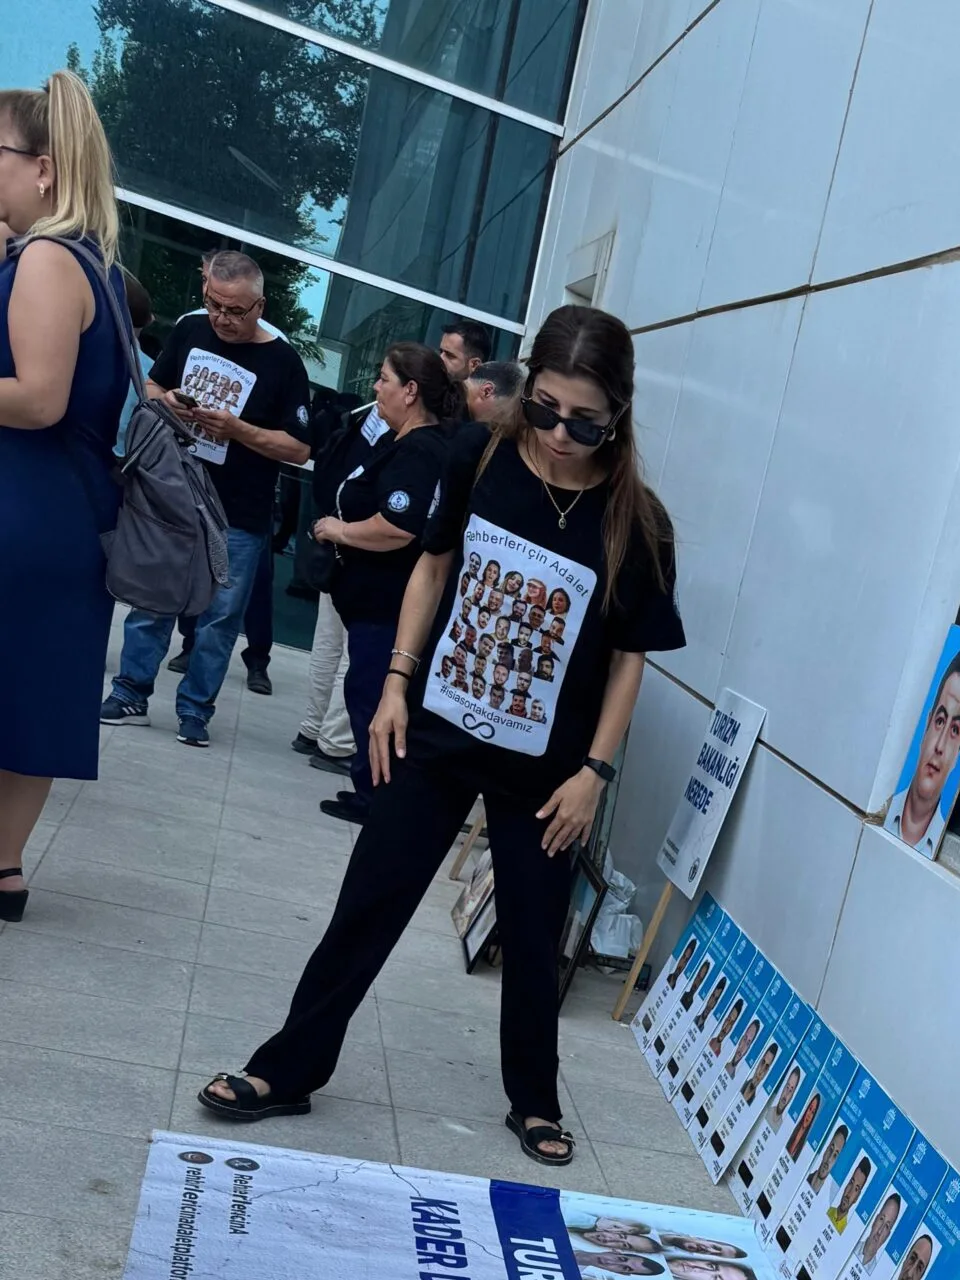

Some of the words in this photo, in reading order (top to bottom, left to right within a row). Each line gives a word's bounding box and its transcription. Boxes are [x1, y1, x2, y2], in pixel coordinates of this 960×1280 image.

[549, 561, 589, 596] Adalet
[440, 683, 533, 733] #isiasortakdavamız
[709, 710, 741, 747] TURİZM
[697, 742, 739, 789] BAKANLIĞI
[410, 1196, 467, 1271] KADER
